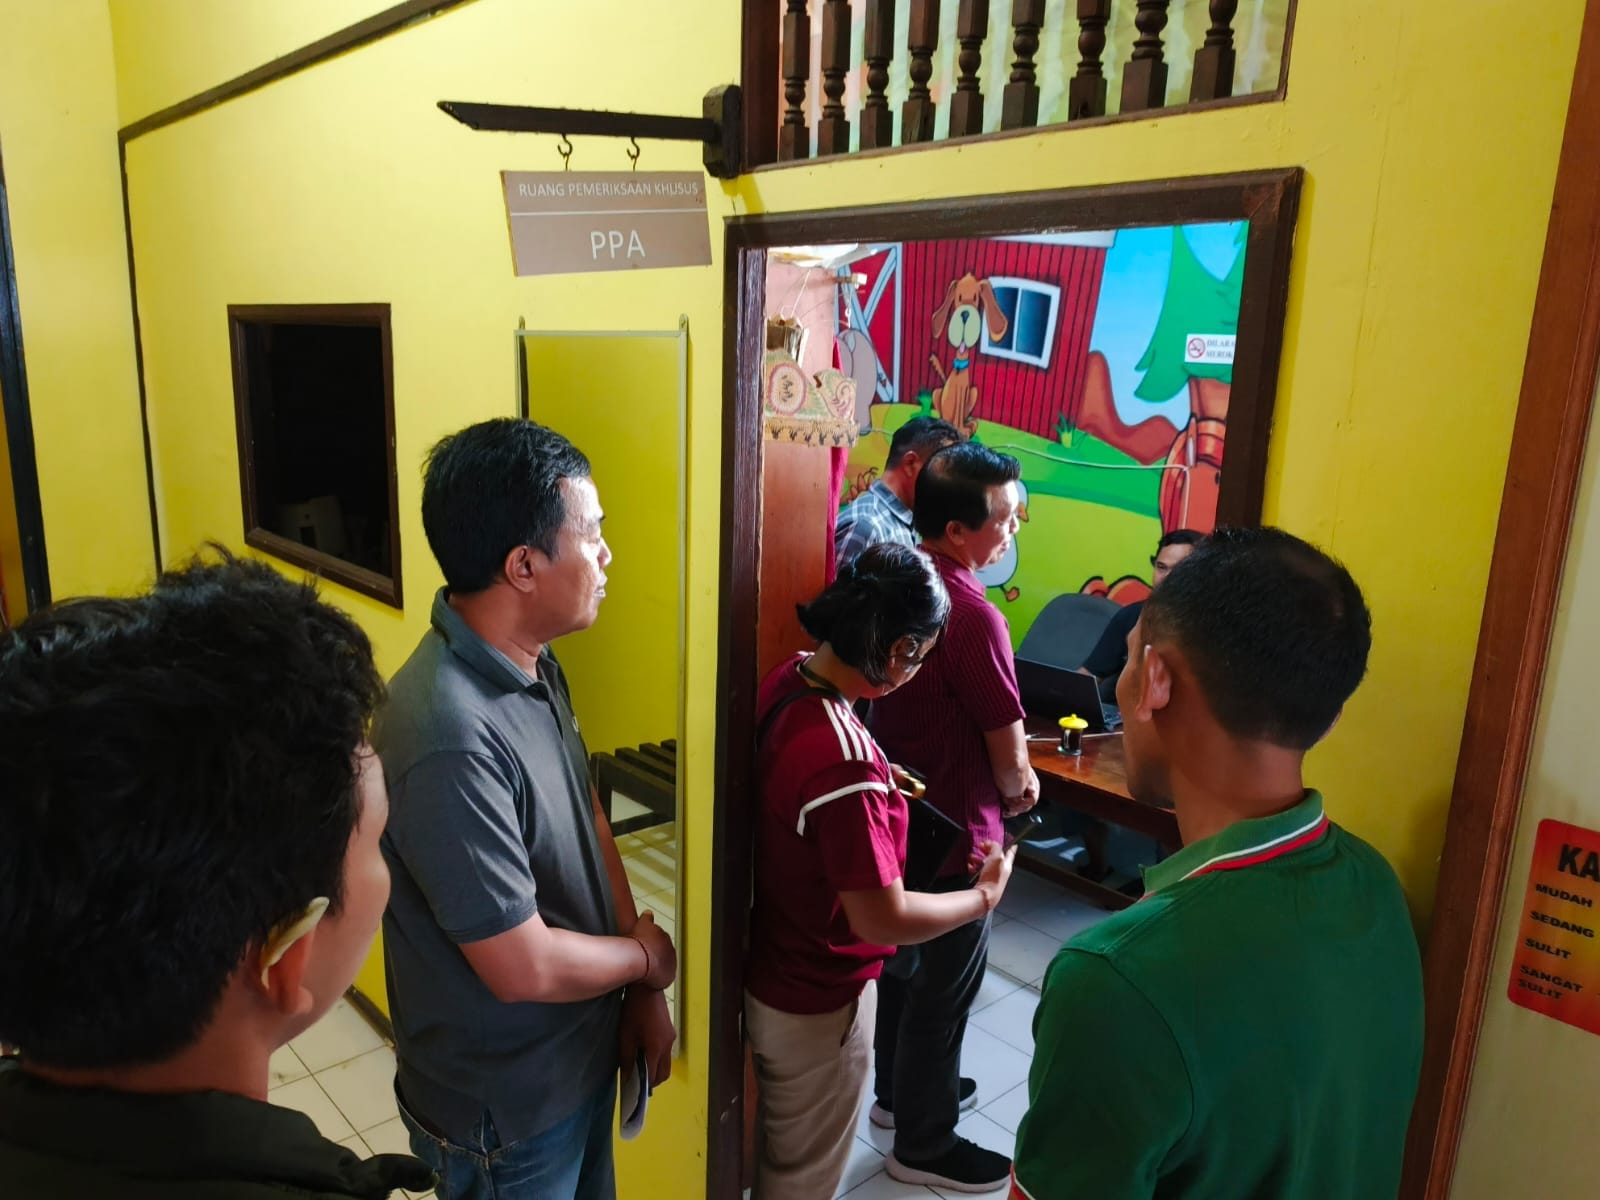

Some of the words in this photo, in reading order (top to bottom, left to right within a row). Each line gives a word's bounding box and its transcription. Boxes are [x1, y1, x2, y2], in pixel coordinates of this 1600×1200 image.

[519, 183, 565, 197] RUANG
[568, 182, 651, 196] PEMERIKSAAN
[656, 181, 698, 195] KHUSUS
[590, 229, 646, 259] PPA
[1535, 883, 1593, 908] MUDAH
[1530, 911, 1595, 938] SEDANG
[1525, 938, 1571, 959] SULIT
[1518, 979, 1563, 1000] SULIT
[1520, 965, 1583, 993] SANGAT
